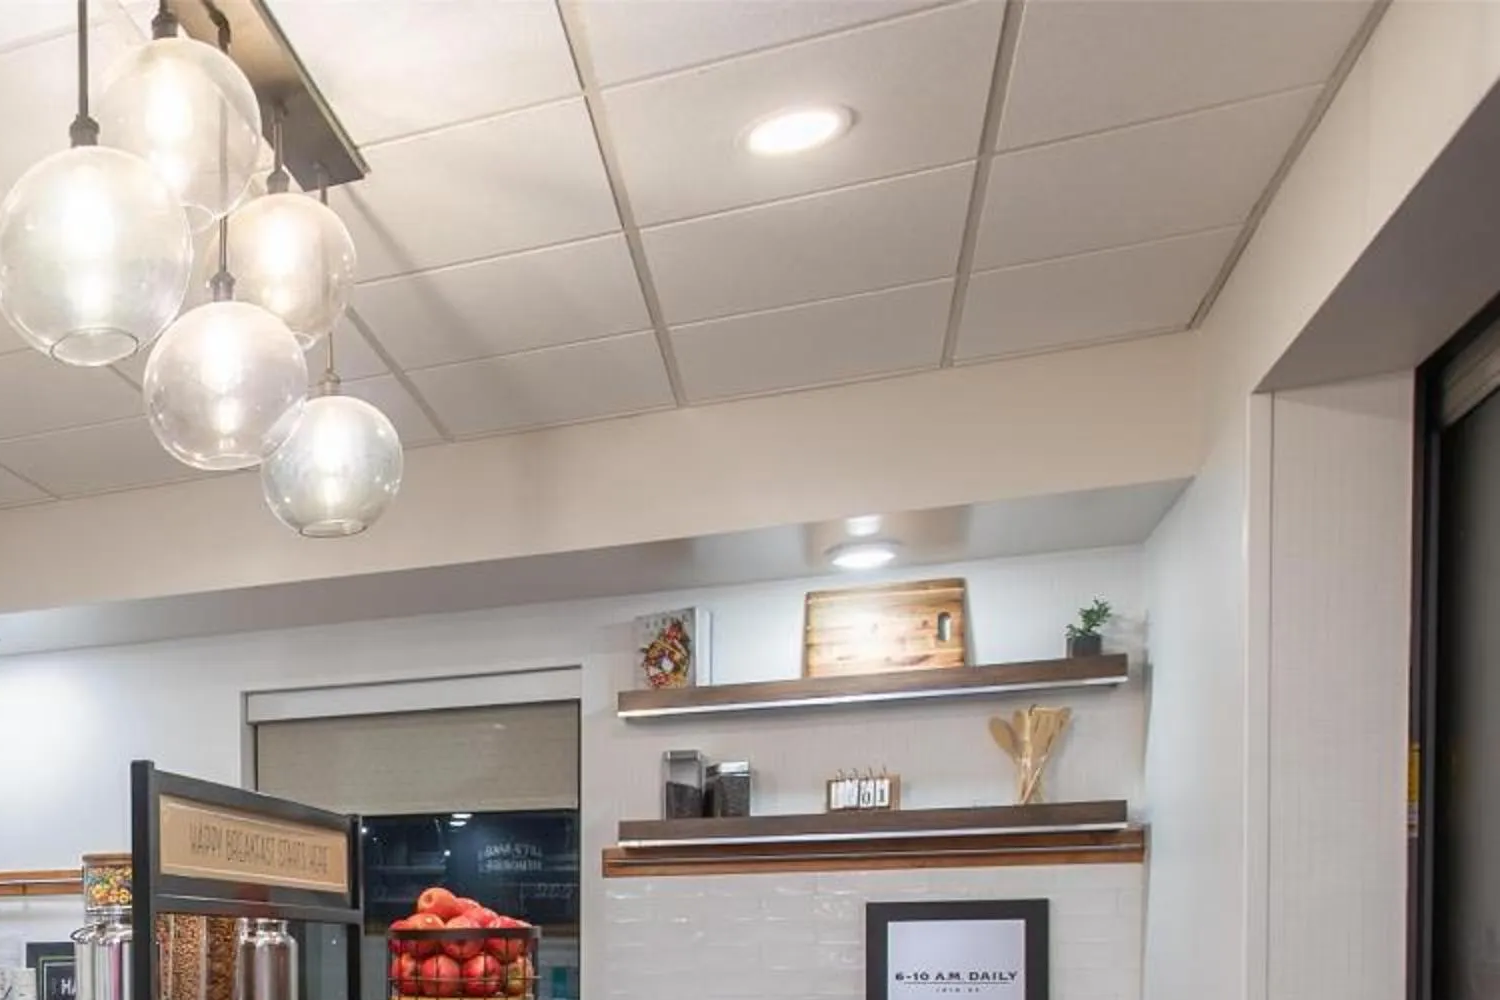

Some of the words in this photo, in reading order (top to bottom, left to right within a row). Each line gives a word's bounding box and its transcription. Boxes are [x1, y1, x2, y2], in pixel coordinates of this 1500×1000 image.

[189, 821, 223, 858] HAPPY
[225, 828, 276, 867] BREAKFAST
[277, 837, 306, 871] STARTS
[895, 971, 930, 981] 6-10
[969, 971, 1018, 981] DAILY
